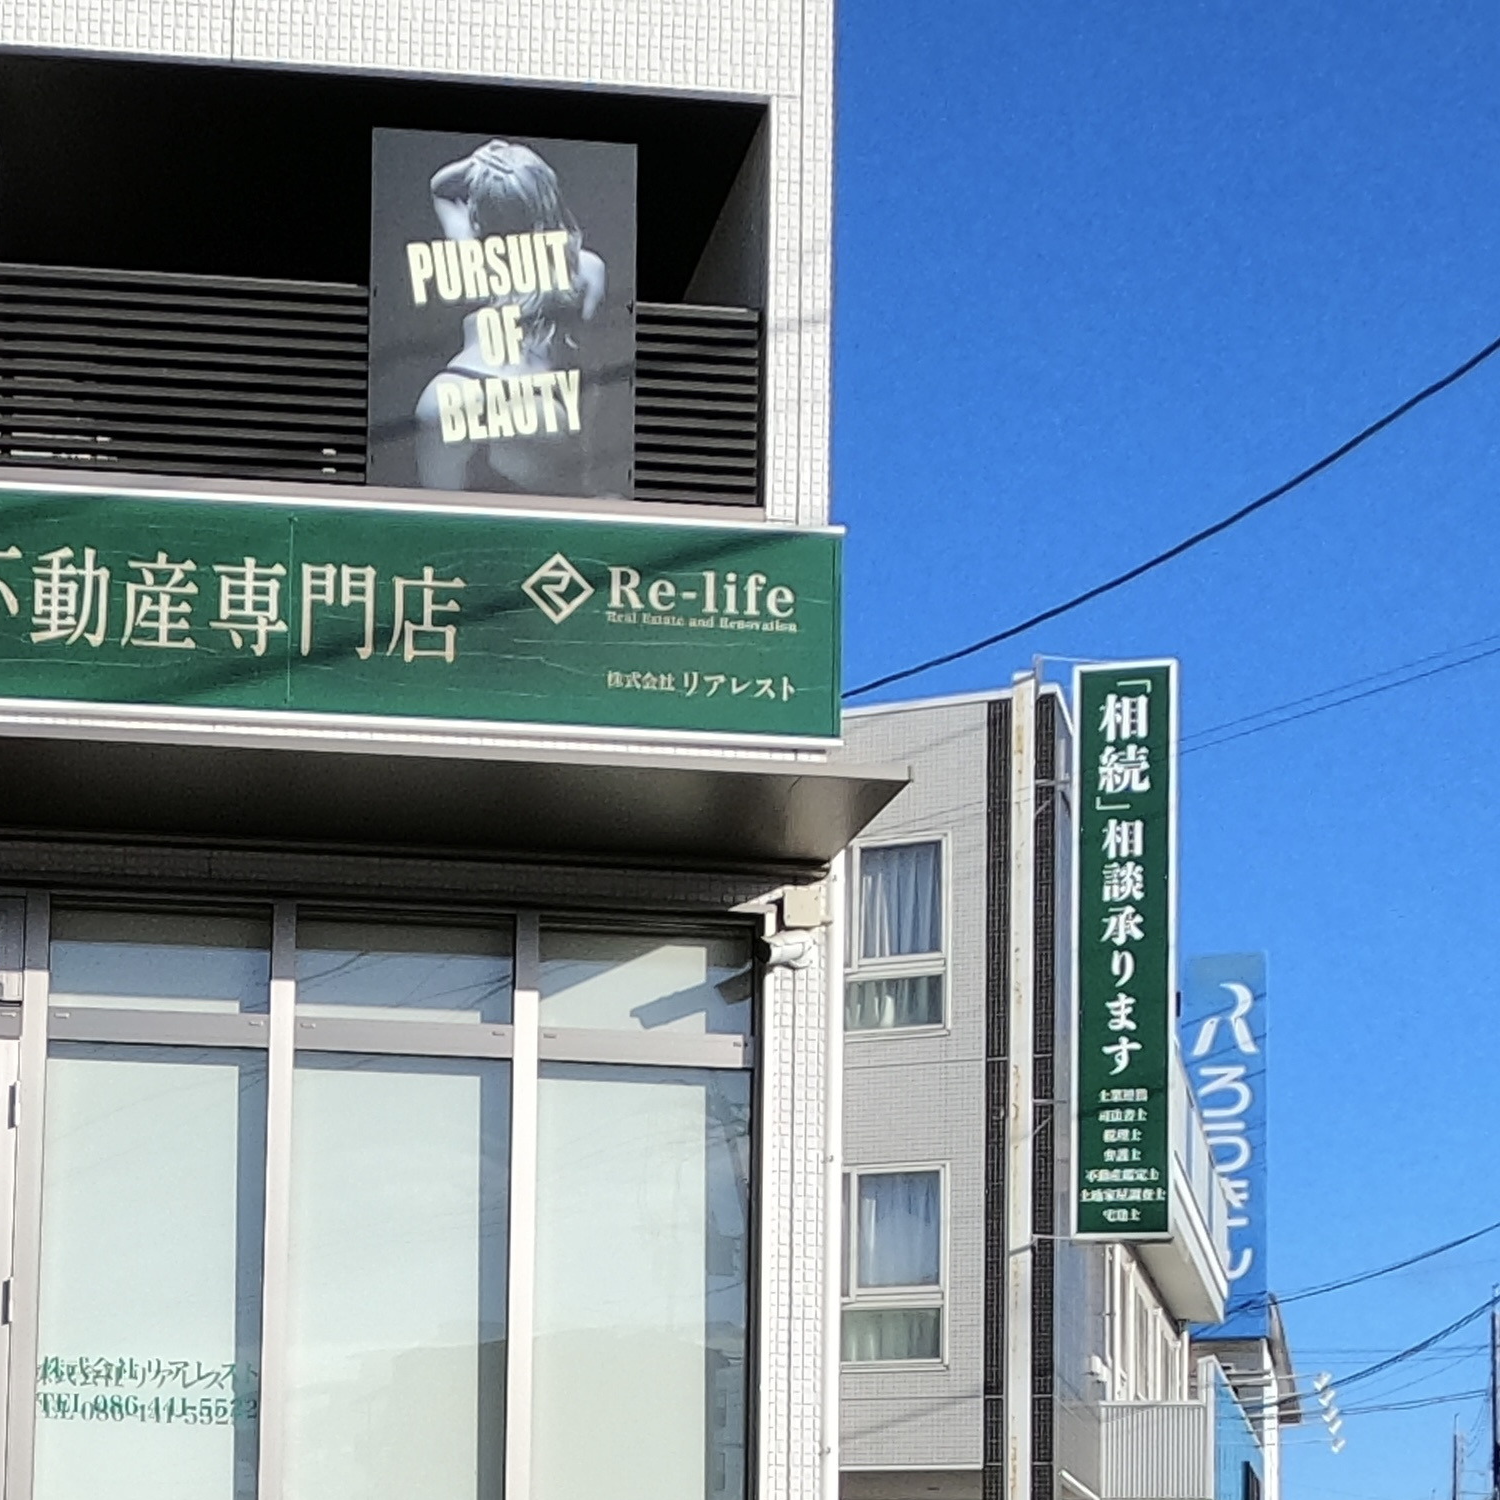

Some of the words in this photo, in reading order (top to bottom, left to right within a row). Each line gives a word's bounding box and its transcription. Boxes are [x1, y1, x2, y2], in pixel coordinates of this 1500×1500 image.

[406, 230, 572, 305] PURSUIT
[476, 304, 524, 366] OF
[436, 368, 581, 443] BEAUTY
[607, 565, 796, 618] Re-life
[688, 615, 715, 629] and
